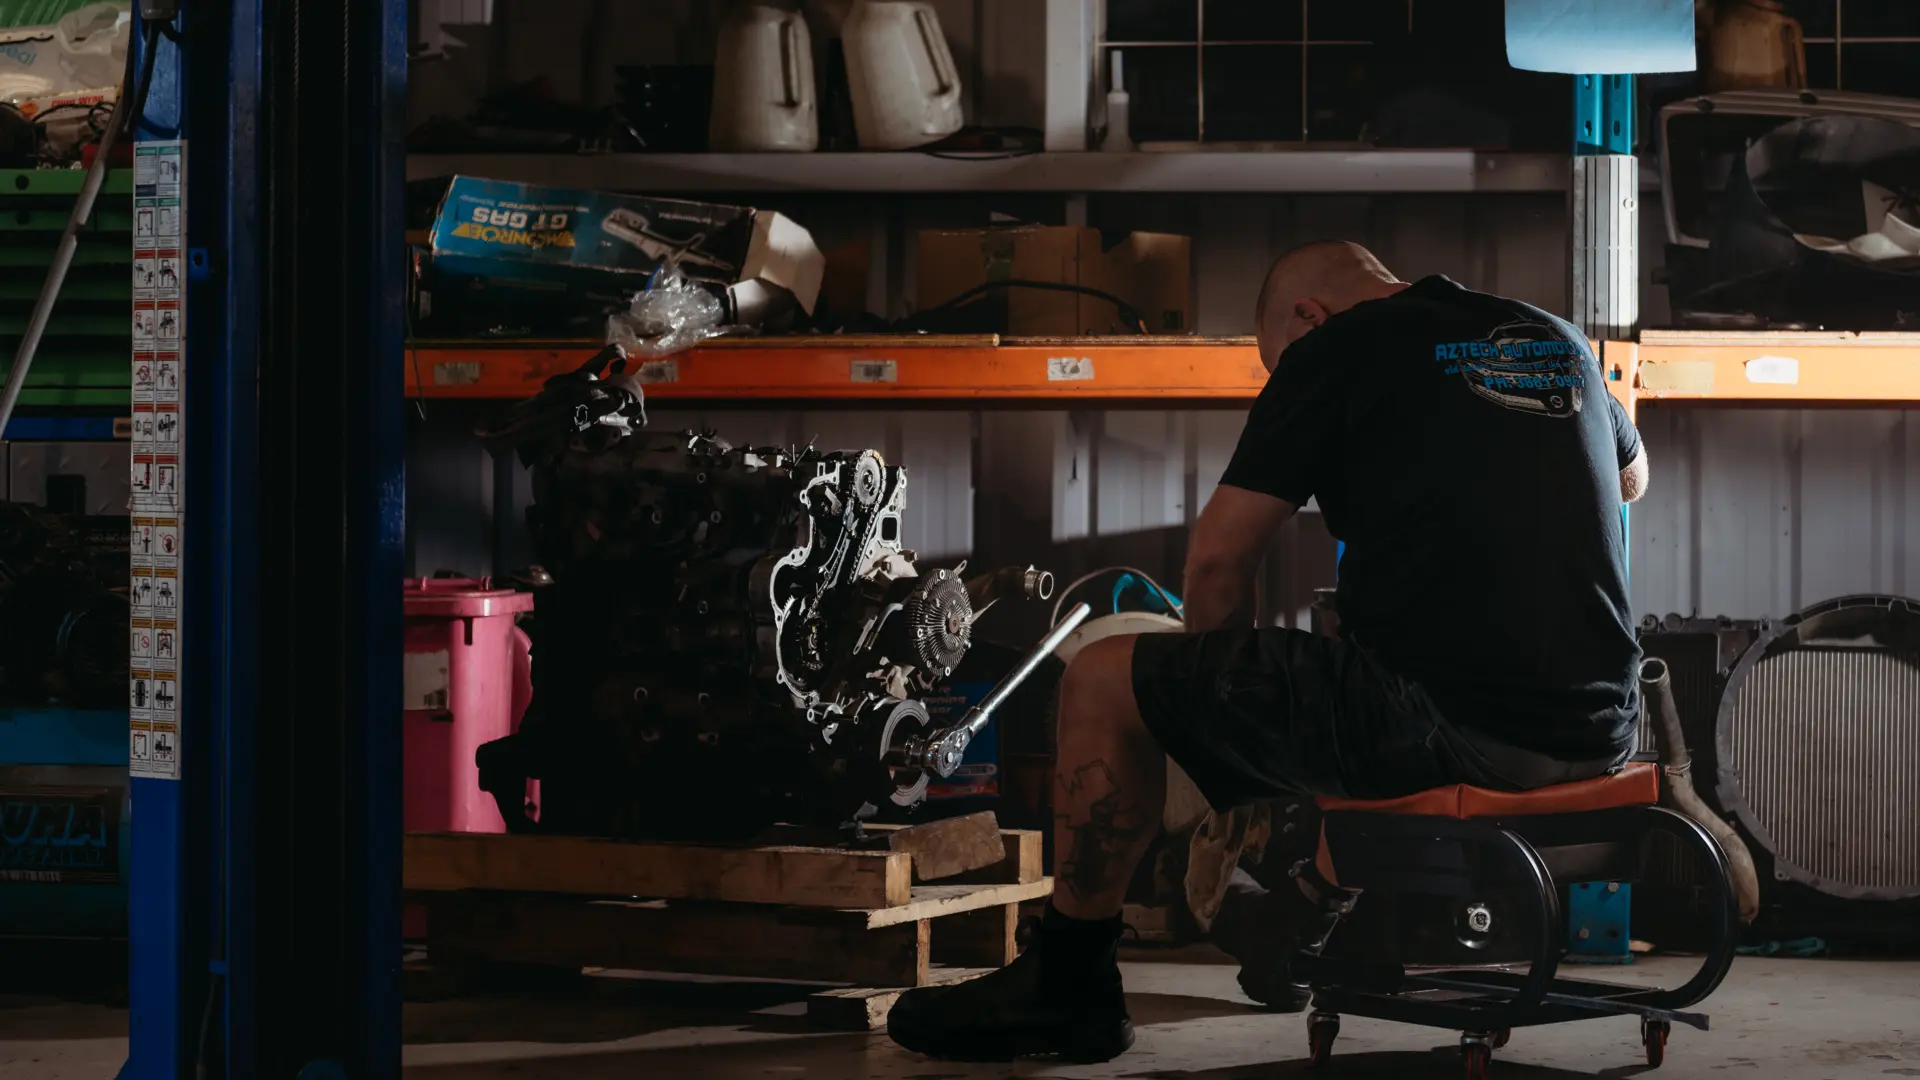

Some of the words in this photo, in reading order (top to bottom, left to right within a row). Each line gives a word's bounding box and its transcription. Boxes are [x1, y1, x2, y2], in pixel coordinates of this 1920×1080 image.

[471, 207, 528, 228] GAS
[531, 213, 568, 231] GT
[471, 223, 564, 248] MONROE
[1435, 341, 1500, 362] AZTECH
